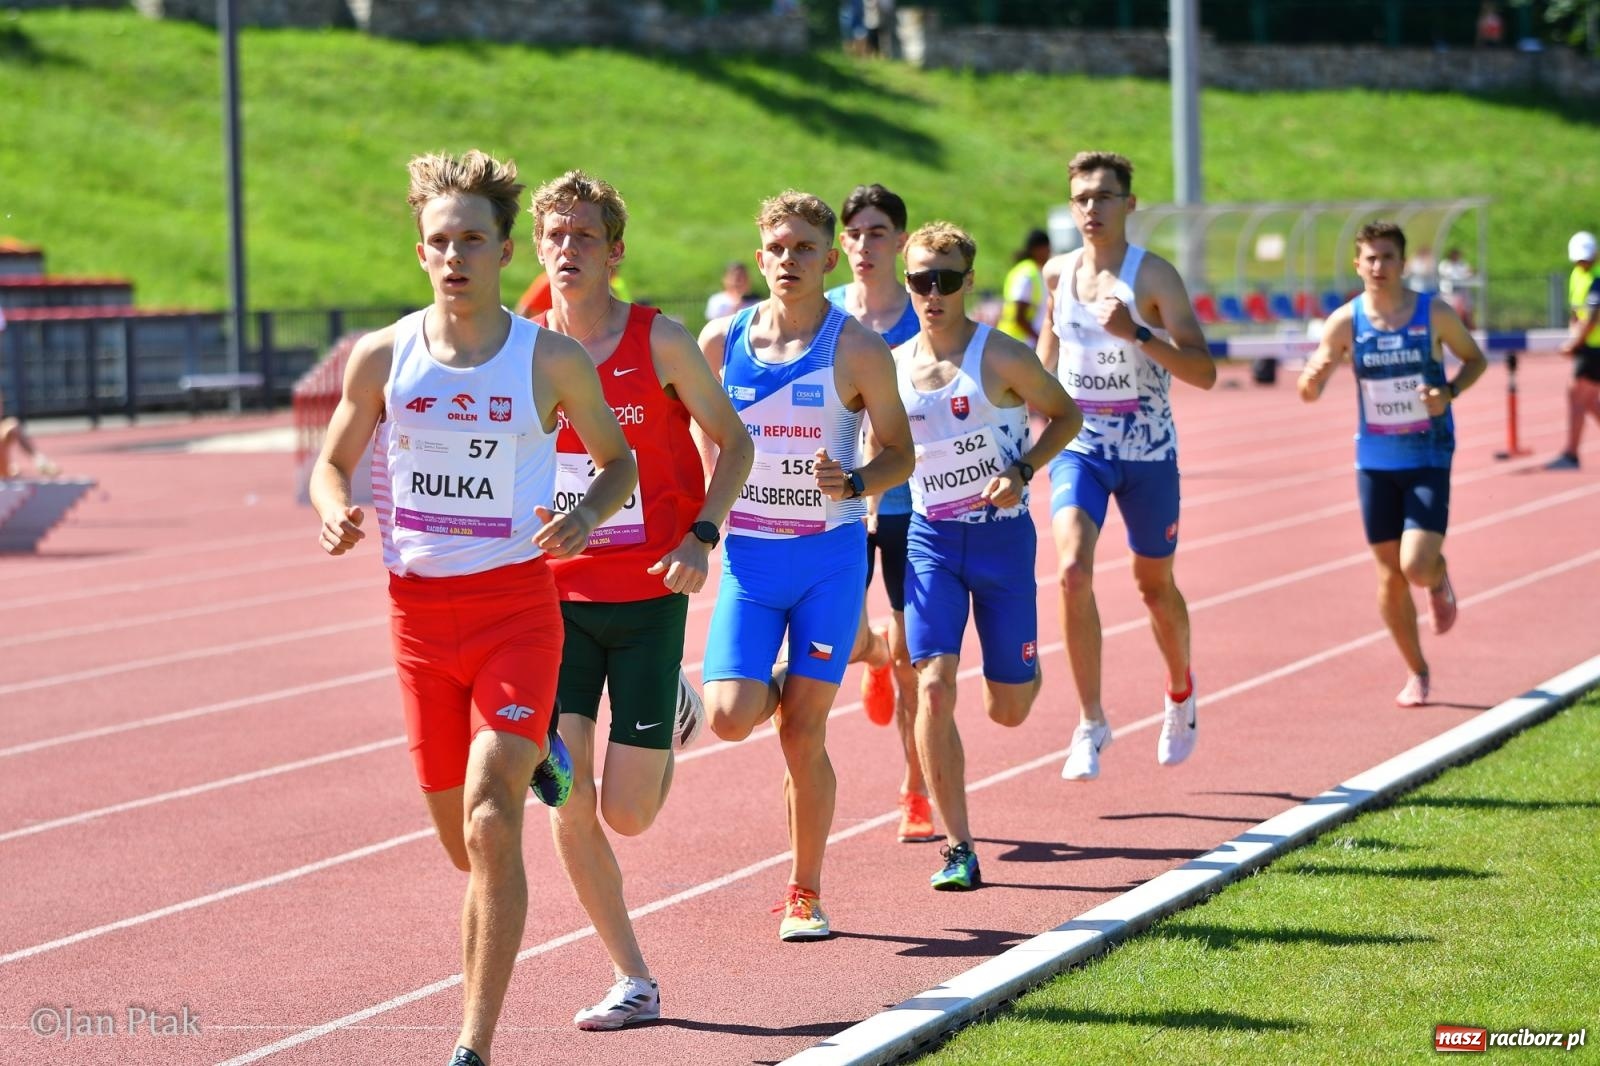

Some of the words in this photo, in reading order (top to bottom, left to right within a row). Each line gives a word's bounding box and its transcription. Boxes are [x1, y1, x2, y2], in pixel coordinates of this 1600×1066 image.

[1097, 350, 1126, 365] 361
[1363, 349, 1421, 367] CROATIA
[406, 397, 438, 413] 4F
[1375, 401, 1412, 416] TOTH
[447, 412, 478, 421] ORLEN
[764, 425, 822, 439] REPUBLIC
[469, 439, 499, 459] 57
[953, 434, 987, 455] 362
[923, 457, 1000, 493] HVOZDÍK
[411, 471, 494, 500] RULKA
[738, 484, 822, 507] DELSBERGER
[496, 703, 535, 721] 4F
